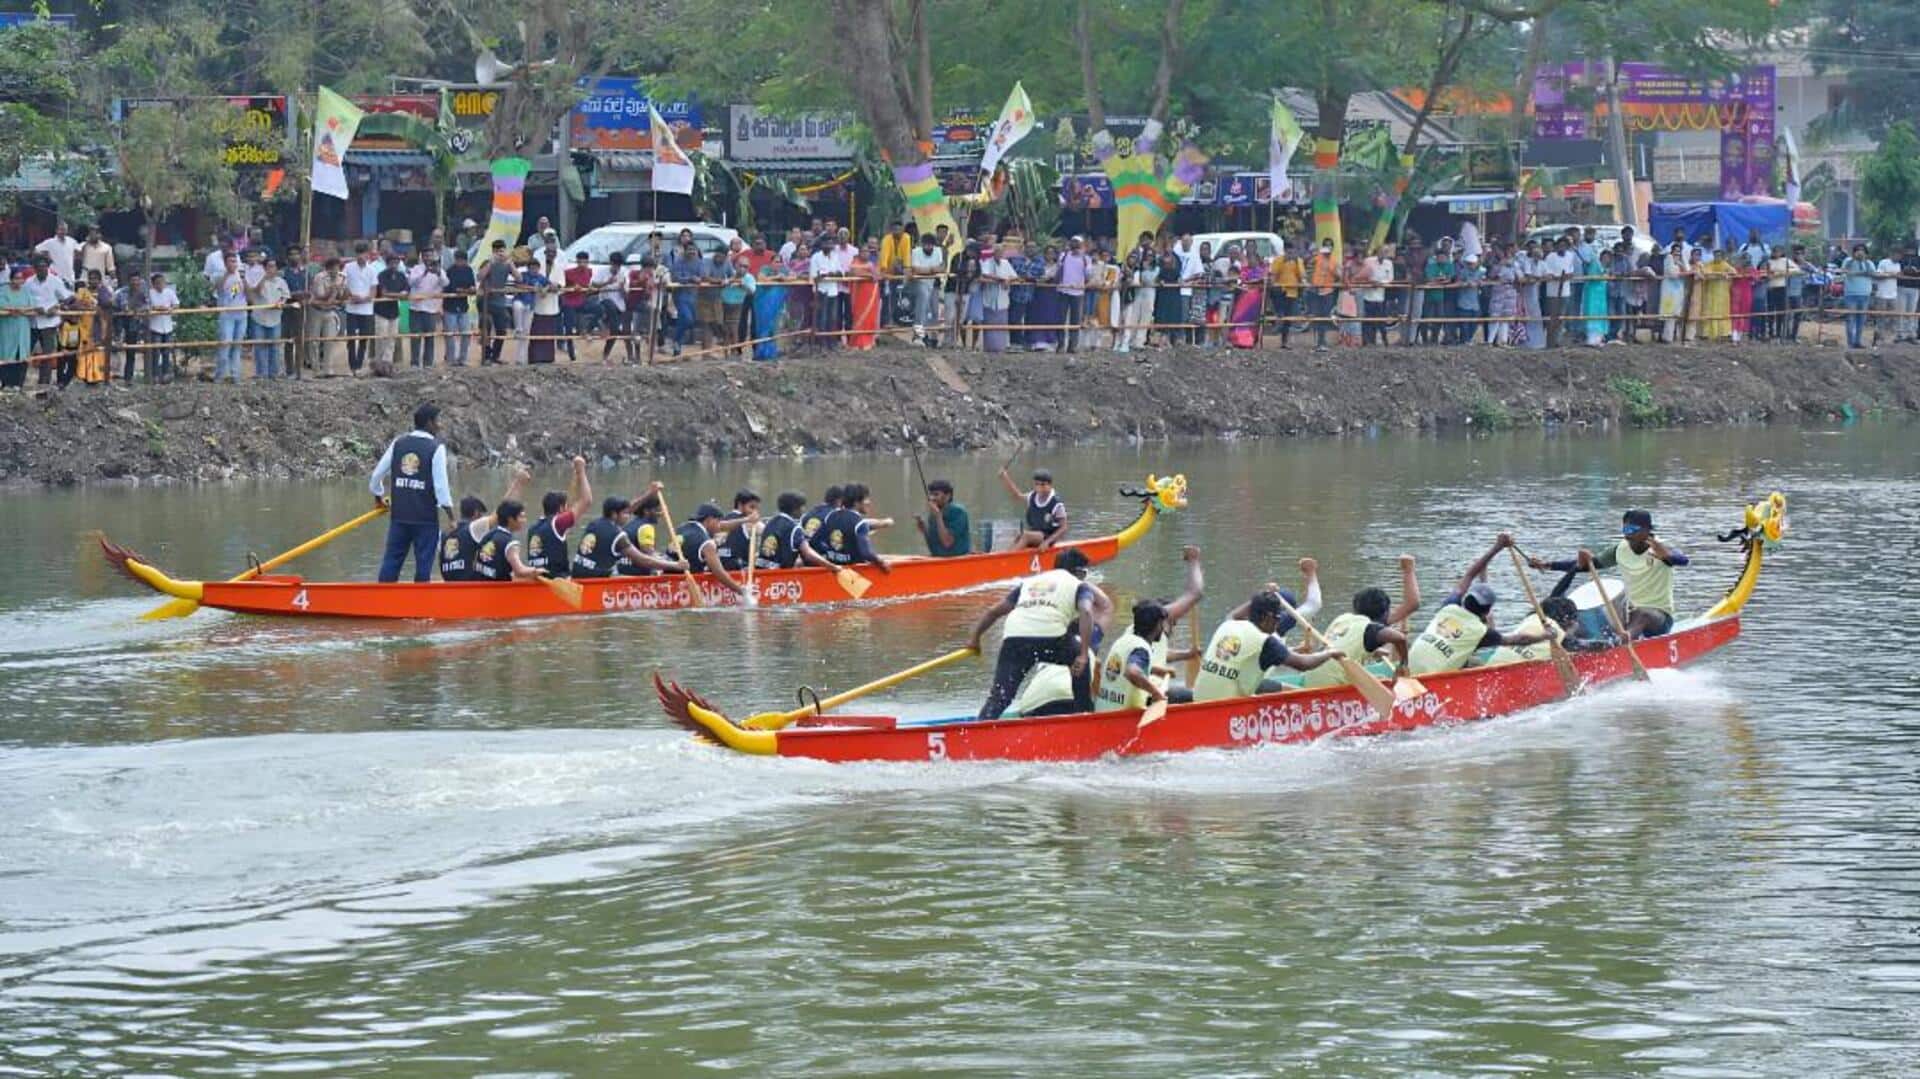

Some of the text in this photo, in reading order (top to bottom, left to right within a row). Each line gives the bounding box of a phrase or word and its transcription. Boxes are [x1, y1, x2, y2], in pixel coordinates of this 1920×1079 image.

[1030, 554, 1041, 574] 4
[291, 589, 310, 611] 4
[1669, 639, 1679, 663] 5
[927, 731, 947, 762] 5
